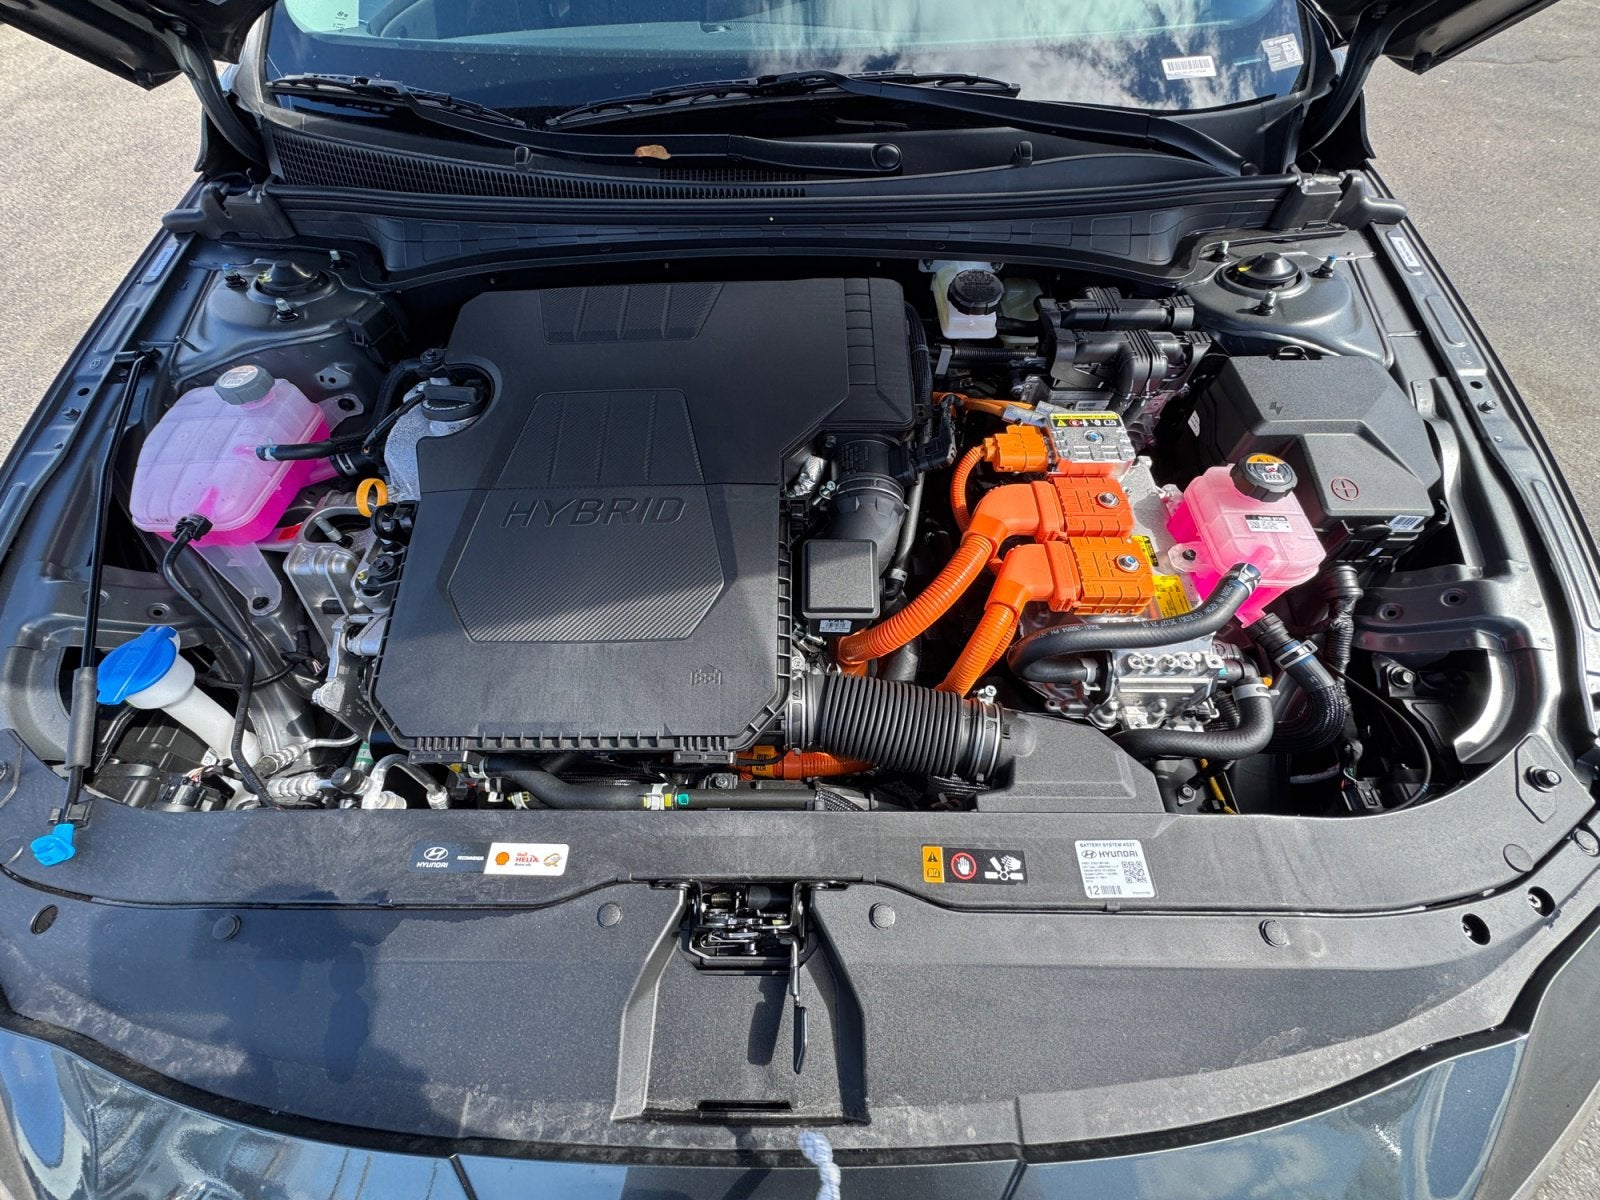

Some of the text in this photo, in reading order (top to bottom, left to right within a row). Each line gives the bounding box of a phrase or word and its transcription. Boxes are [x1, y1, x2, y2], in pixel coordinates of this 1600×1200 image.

[500, 497, 687, 529] HYBRID
[1098, 850, 1139, 858] HYUNDAI
[1088, 885, 1101, 896] 12
